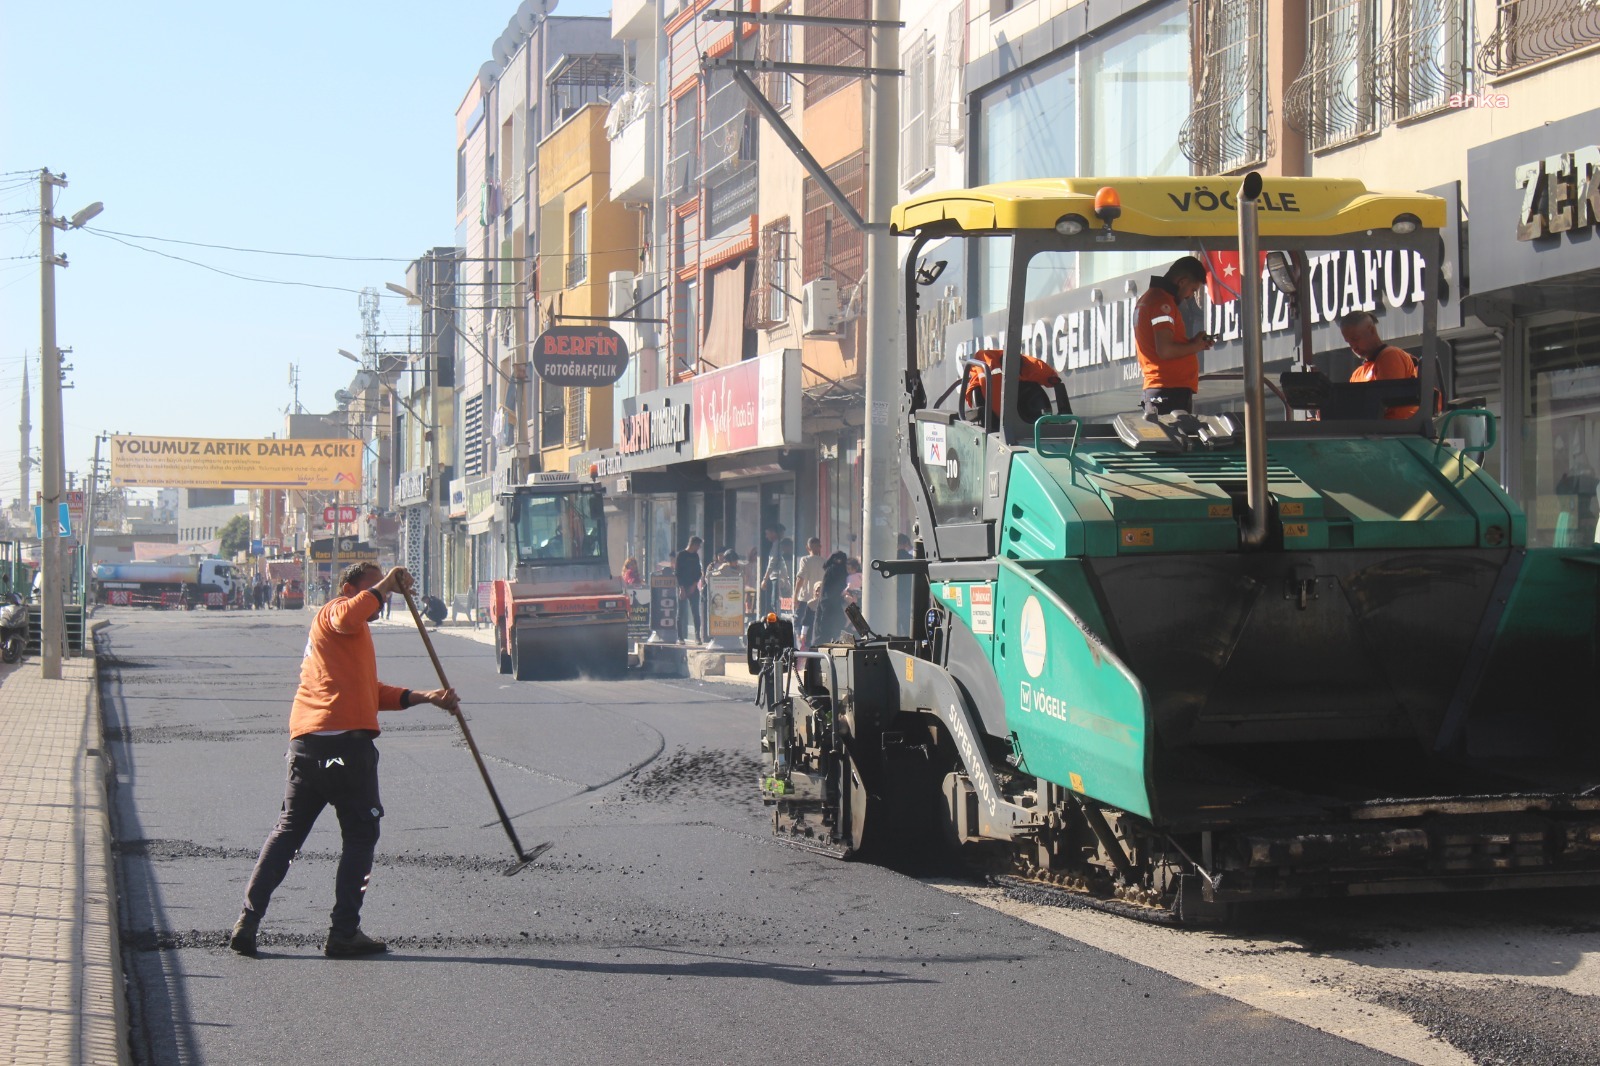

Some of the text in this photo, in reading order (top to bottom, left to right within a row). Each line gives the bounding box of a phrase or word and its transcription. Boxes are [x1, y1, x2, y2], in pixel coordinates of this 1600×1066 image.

[1168, 186, 1300, 212] VÖGLE
[1052, 279, 1137, 373] GELİNLİ
[543, 331, 618, 356] BERFİN
[544, 361, 617, 379] FOTOĞRAFÇILIK
[116, 440, 356, 459] YOLUMUZ ARTIK DAHA AÇIK!
[327, 509, 353, 520] BM
[1033, 687, 1067, 721] VÖGELE
[949, 703, 997, 817] SUPER 1900-3
